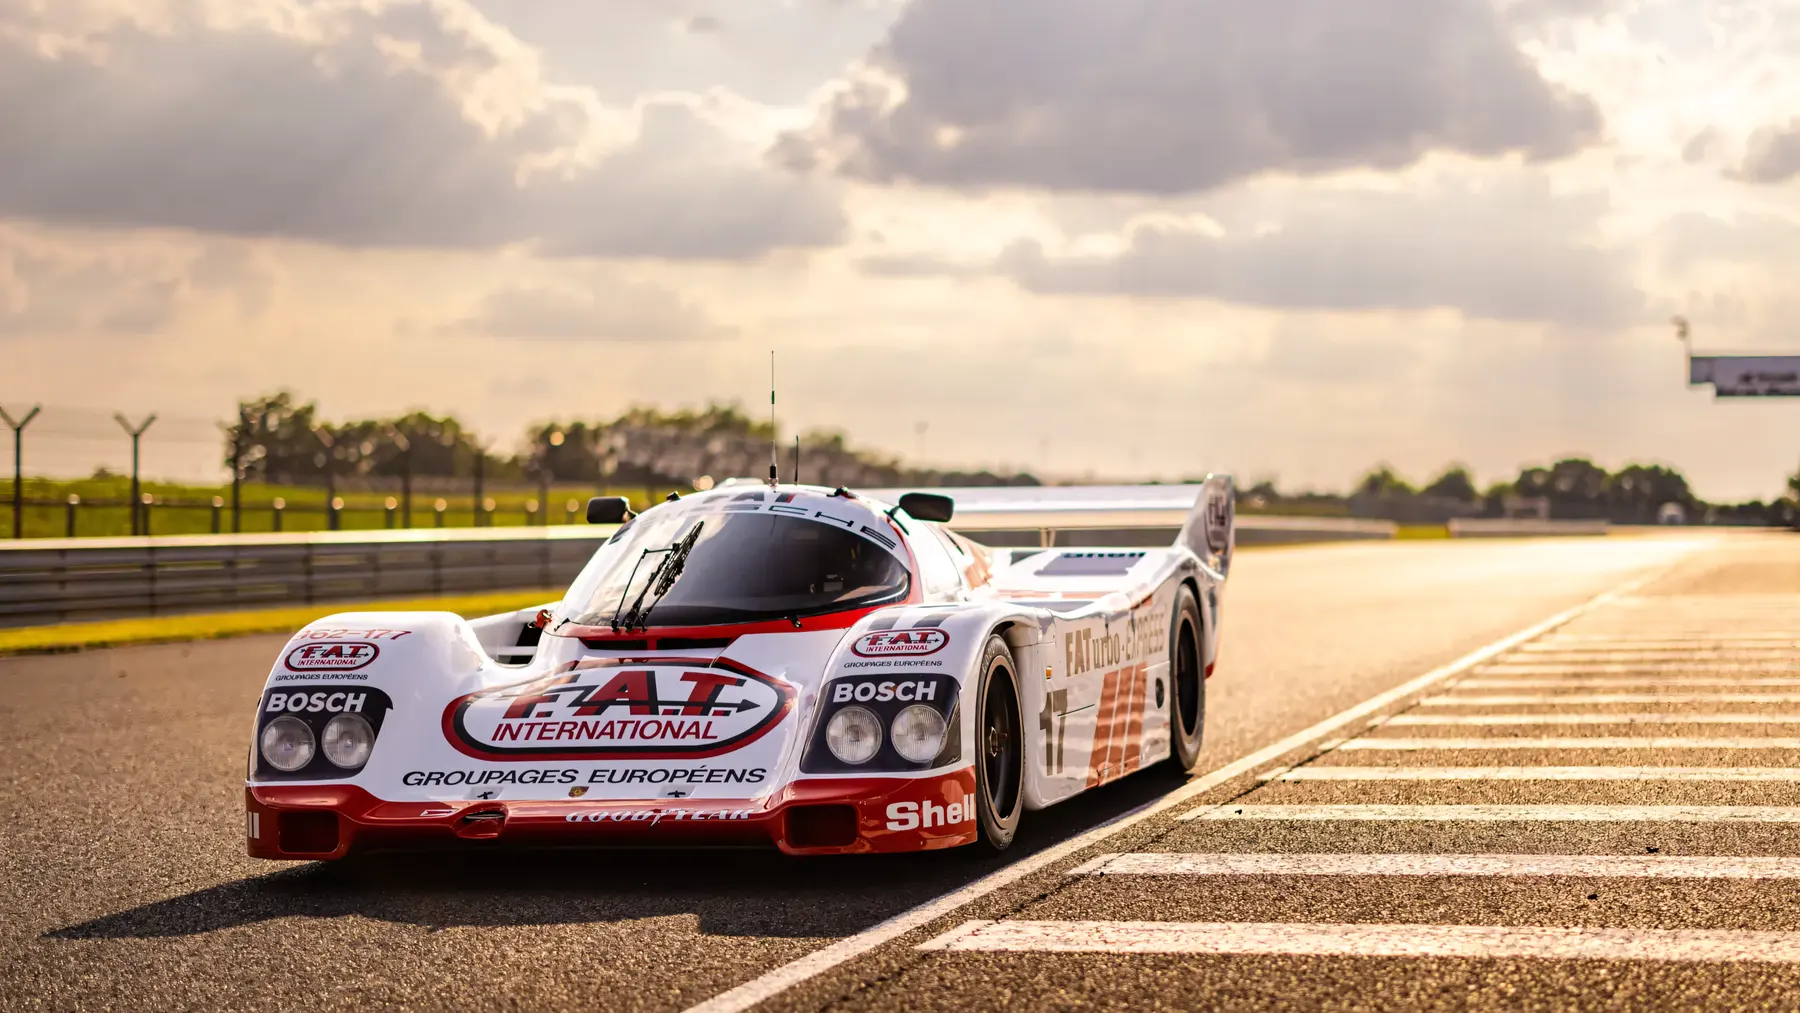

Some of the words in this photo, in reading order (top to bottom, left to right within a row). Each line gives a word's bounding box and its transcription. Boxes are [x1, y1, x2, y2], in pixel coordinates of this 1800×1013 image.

[865, 644, 928, 653] INTERNATIONAL
[275, 673, 320, 681] GROUPAGES
[322, 673, 368, 681] EUROPÉENS
[265, 692, 366, 713] BOSCH
[833, 681, 937, 703] BOSCH
[491, 720, 719, 742] INTERNATIONAL
[1039, 689, 1068, 776] 17
[402, 769, 578, 786] GROUPAGES
[588, 765, 766, 784] EUROPÉENS
[886, 793, 975, 832] Shell
